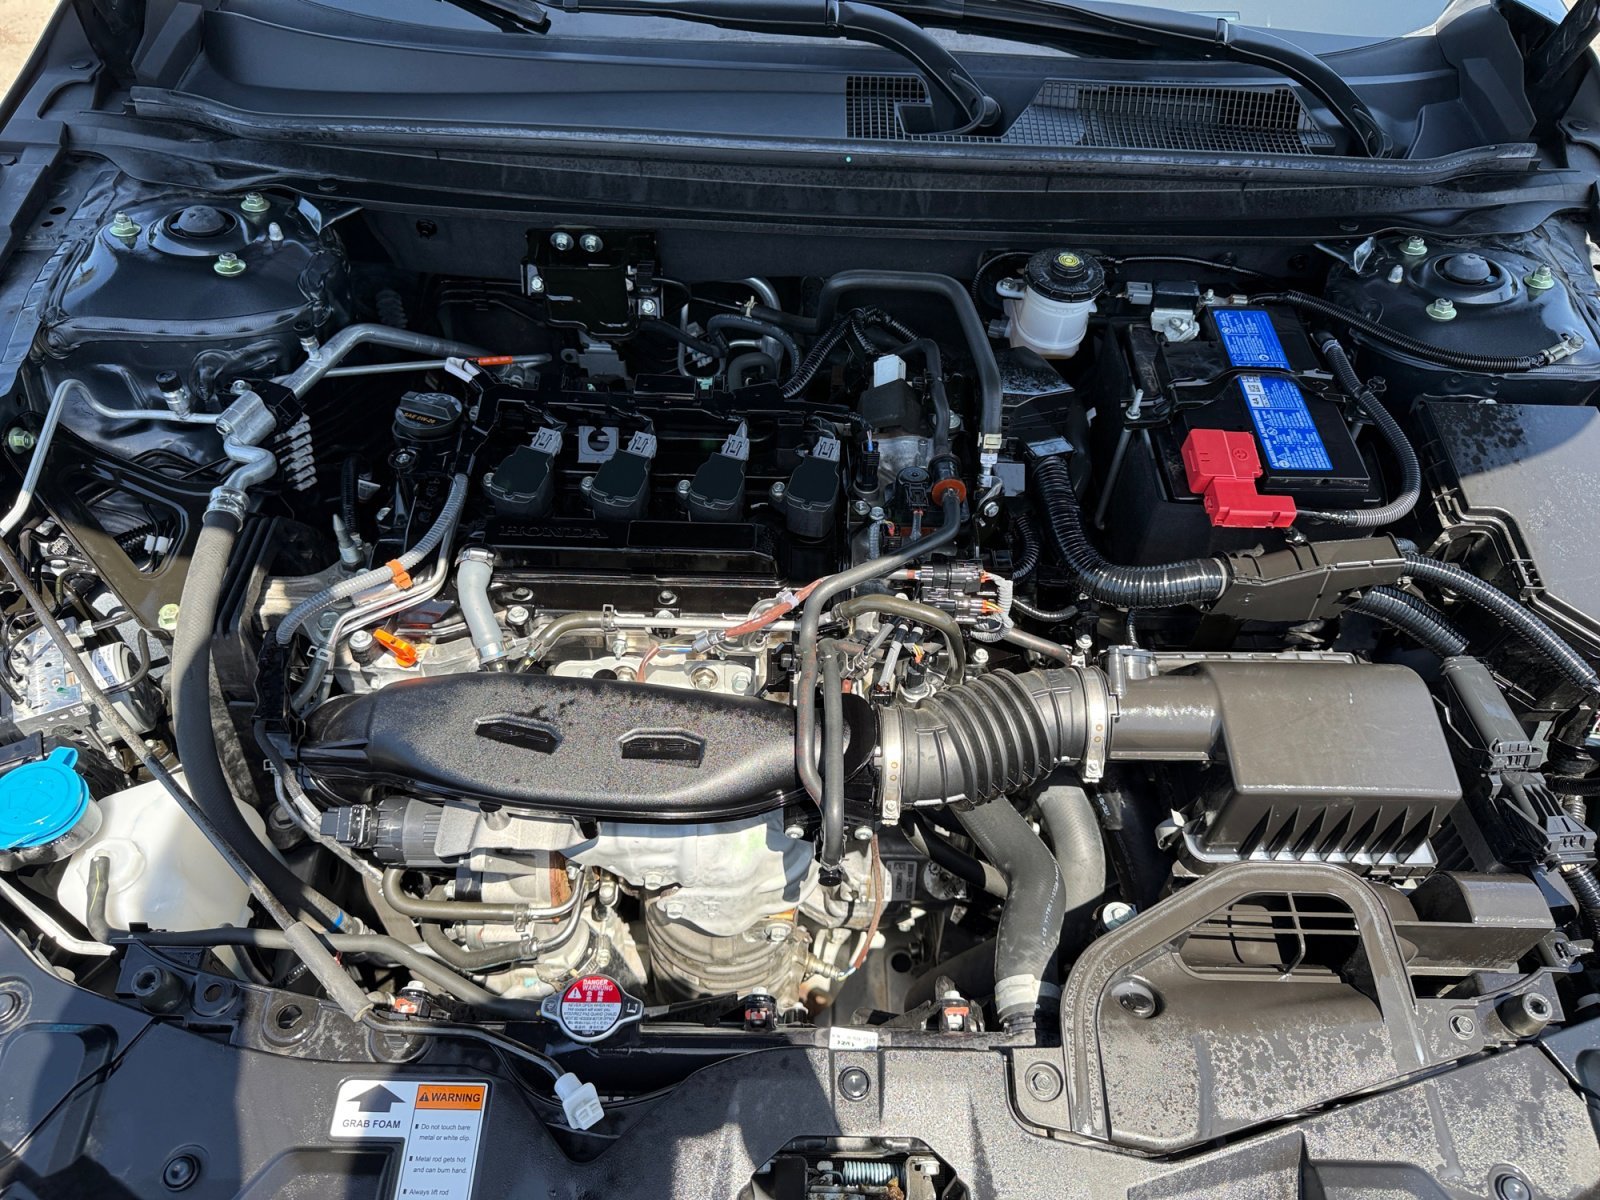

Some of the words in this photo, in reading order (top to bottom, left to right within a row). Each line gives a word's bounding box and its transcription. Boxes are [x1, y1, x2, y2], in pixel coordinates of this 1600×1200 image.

[499, 526, 609, 539] HONDA
[432, 1092, 481, 1102] WARNING
[342, 1119, 370, 1128] GRAB
[372, 1119, 401, 1129] FOAM
